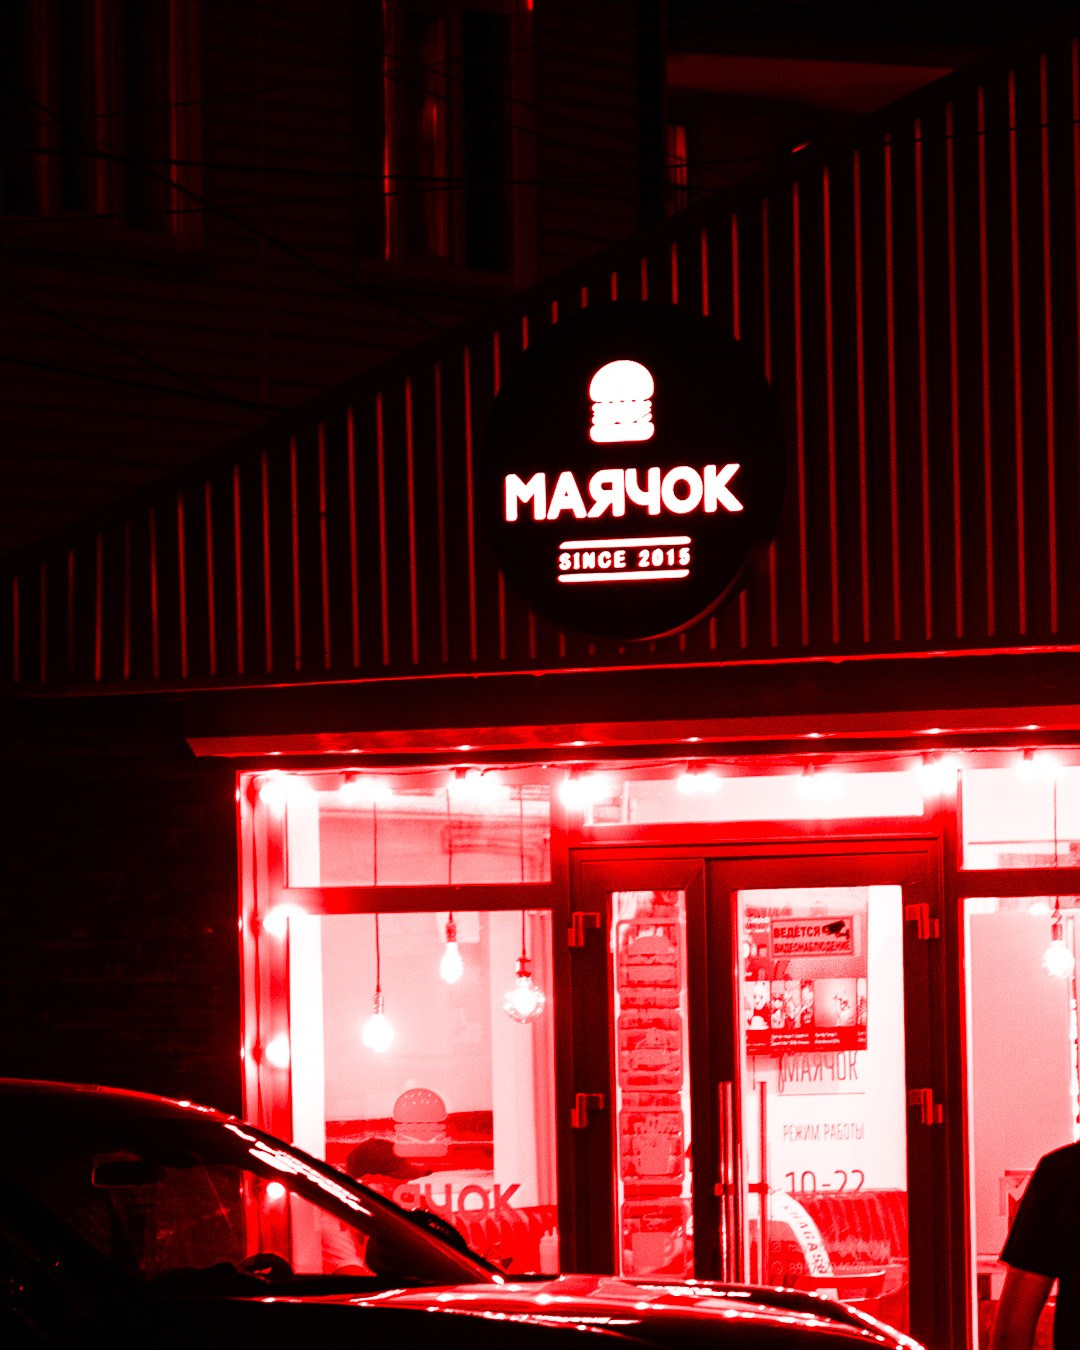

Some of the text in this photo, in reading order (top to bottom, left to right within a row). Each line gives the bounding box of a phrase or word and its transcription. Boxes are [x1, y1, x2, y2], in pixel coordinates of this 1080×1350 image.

[505, 463, 744, 522] МАЯЧОК
[558, 547, 691, 570] SINCE 2015
[783, 1052, 859, 1082] МАЯЧОК
[783, 1123, 865, 1142] РЕЖИМ РАБОТЫ
[785, 1169, 865, 1198] 10-22
